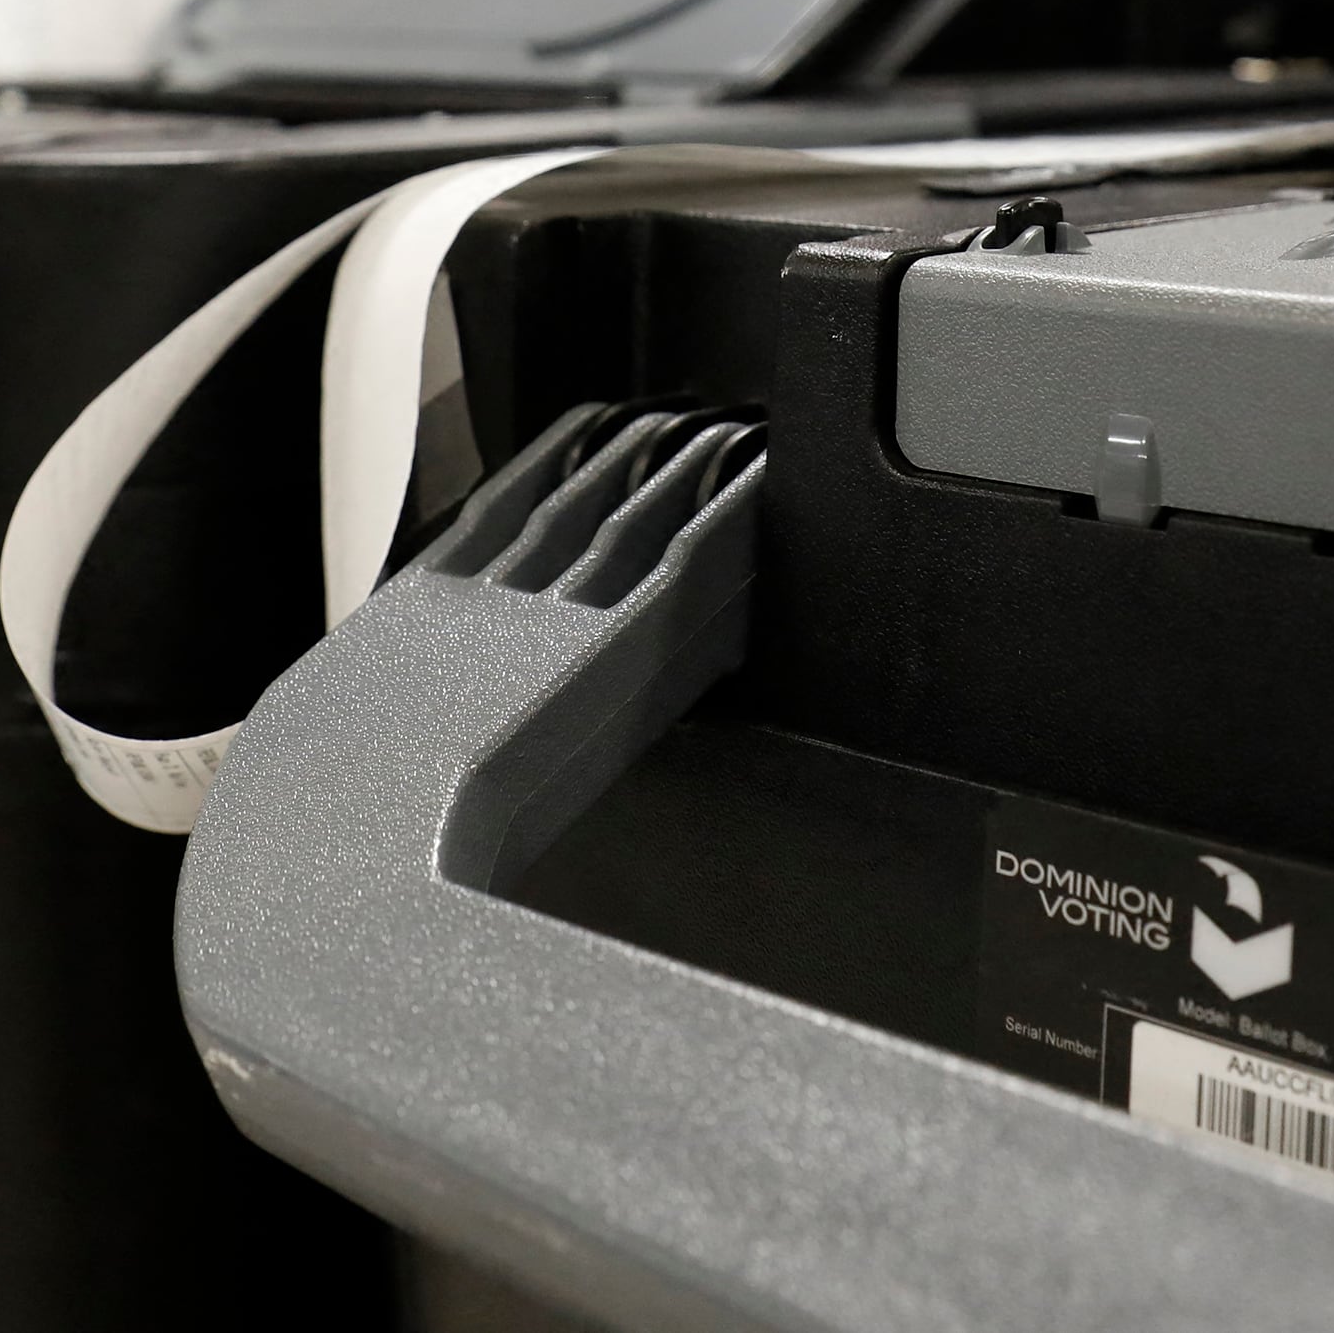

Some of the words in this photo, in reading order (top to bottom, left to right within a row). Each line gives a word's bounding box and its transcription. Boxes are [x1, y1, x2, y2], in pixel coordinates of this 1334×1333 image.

[995, 848, 1174, 924] DOMINION
[1038, 888, 1172, 952] VOTING
[1004, 1015, 1043, 1042] Serial
[1044, 1028, 1101, 1060] Number
[1238, 1013, 1289, 1048] Ballot
